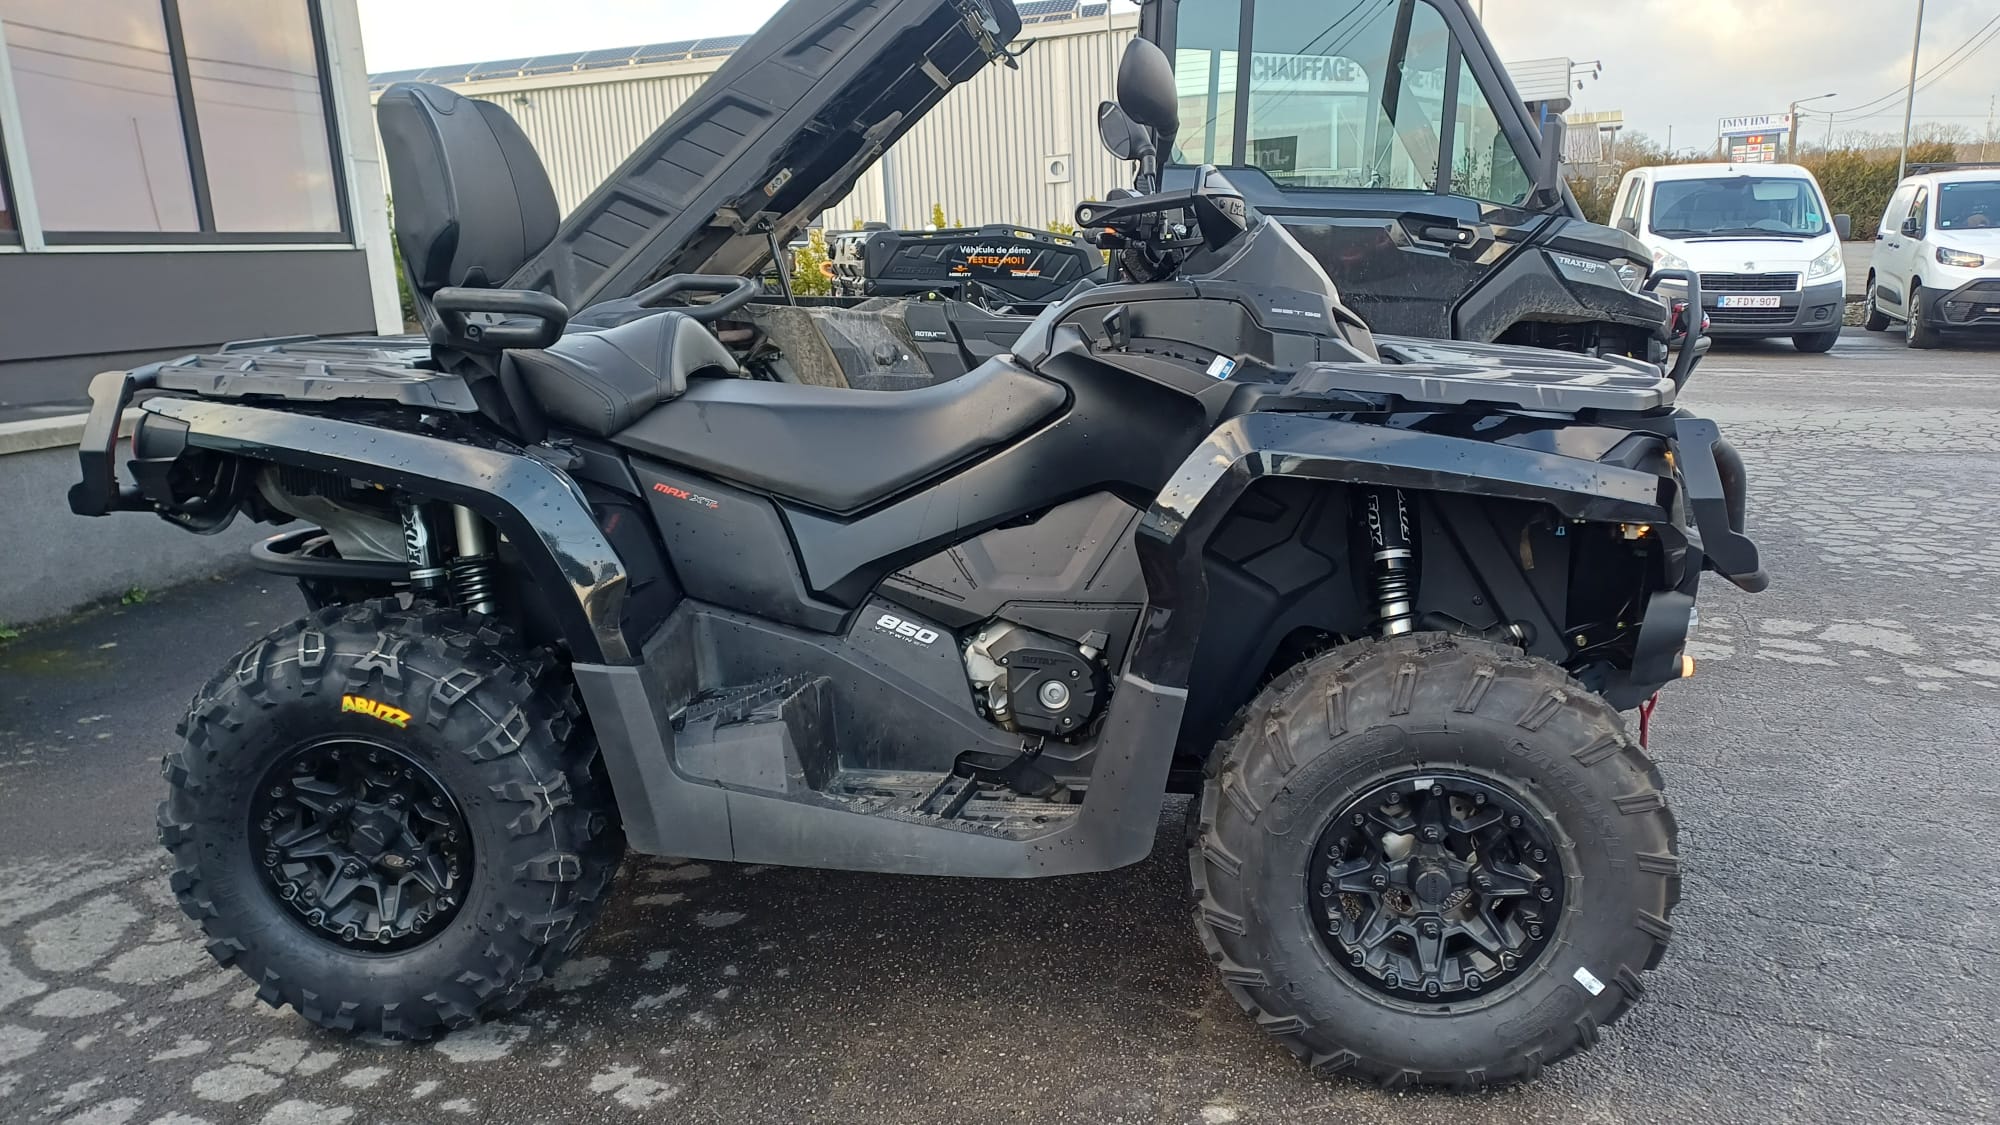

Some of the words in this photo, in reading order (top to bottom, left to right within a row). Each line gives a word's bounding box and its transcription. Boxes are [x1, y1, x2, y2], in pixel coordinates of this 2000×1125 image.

[1252, 55, 1355, 81] CHAUFFAGE
[960, 245, 994, 254] Véhicule
[996, 246, 1007, 254] de
[1009, 246, 1032, 254] démo
[1558, 256, 1597, 269] TRAXTER
[1725, 297, 1778, 306] 2-FDY-907
[915, 330, 940, 338] ROTAX
[652, 482, 690, 500] MAX
[401, 510, 426, 567] FOX
[876, 614, 940, 644] 850
[341, 694, 412, 729] ABUZZ
